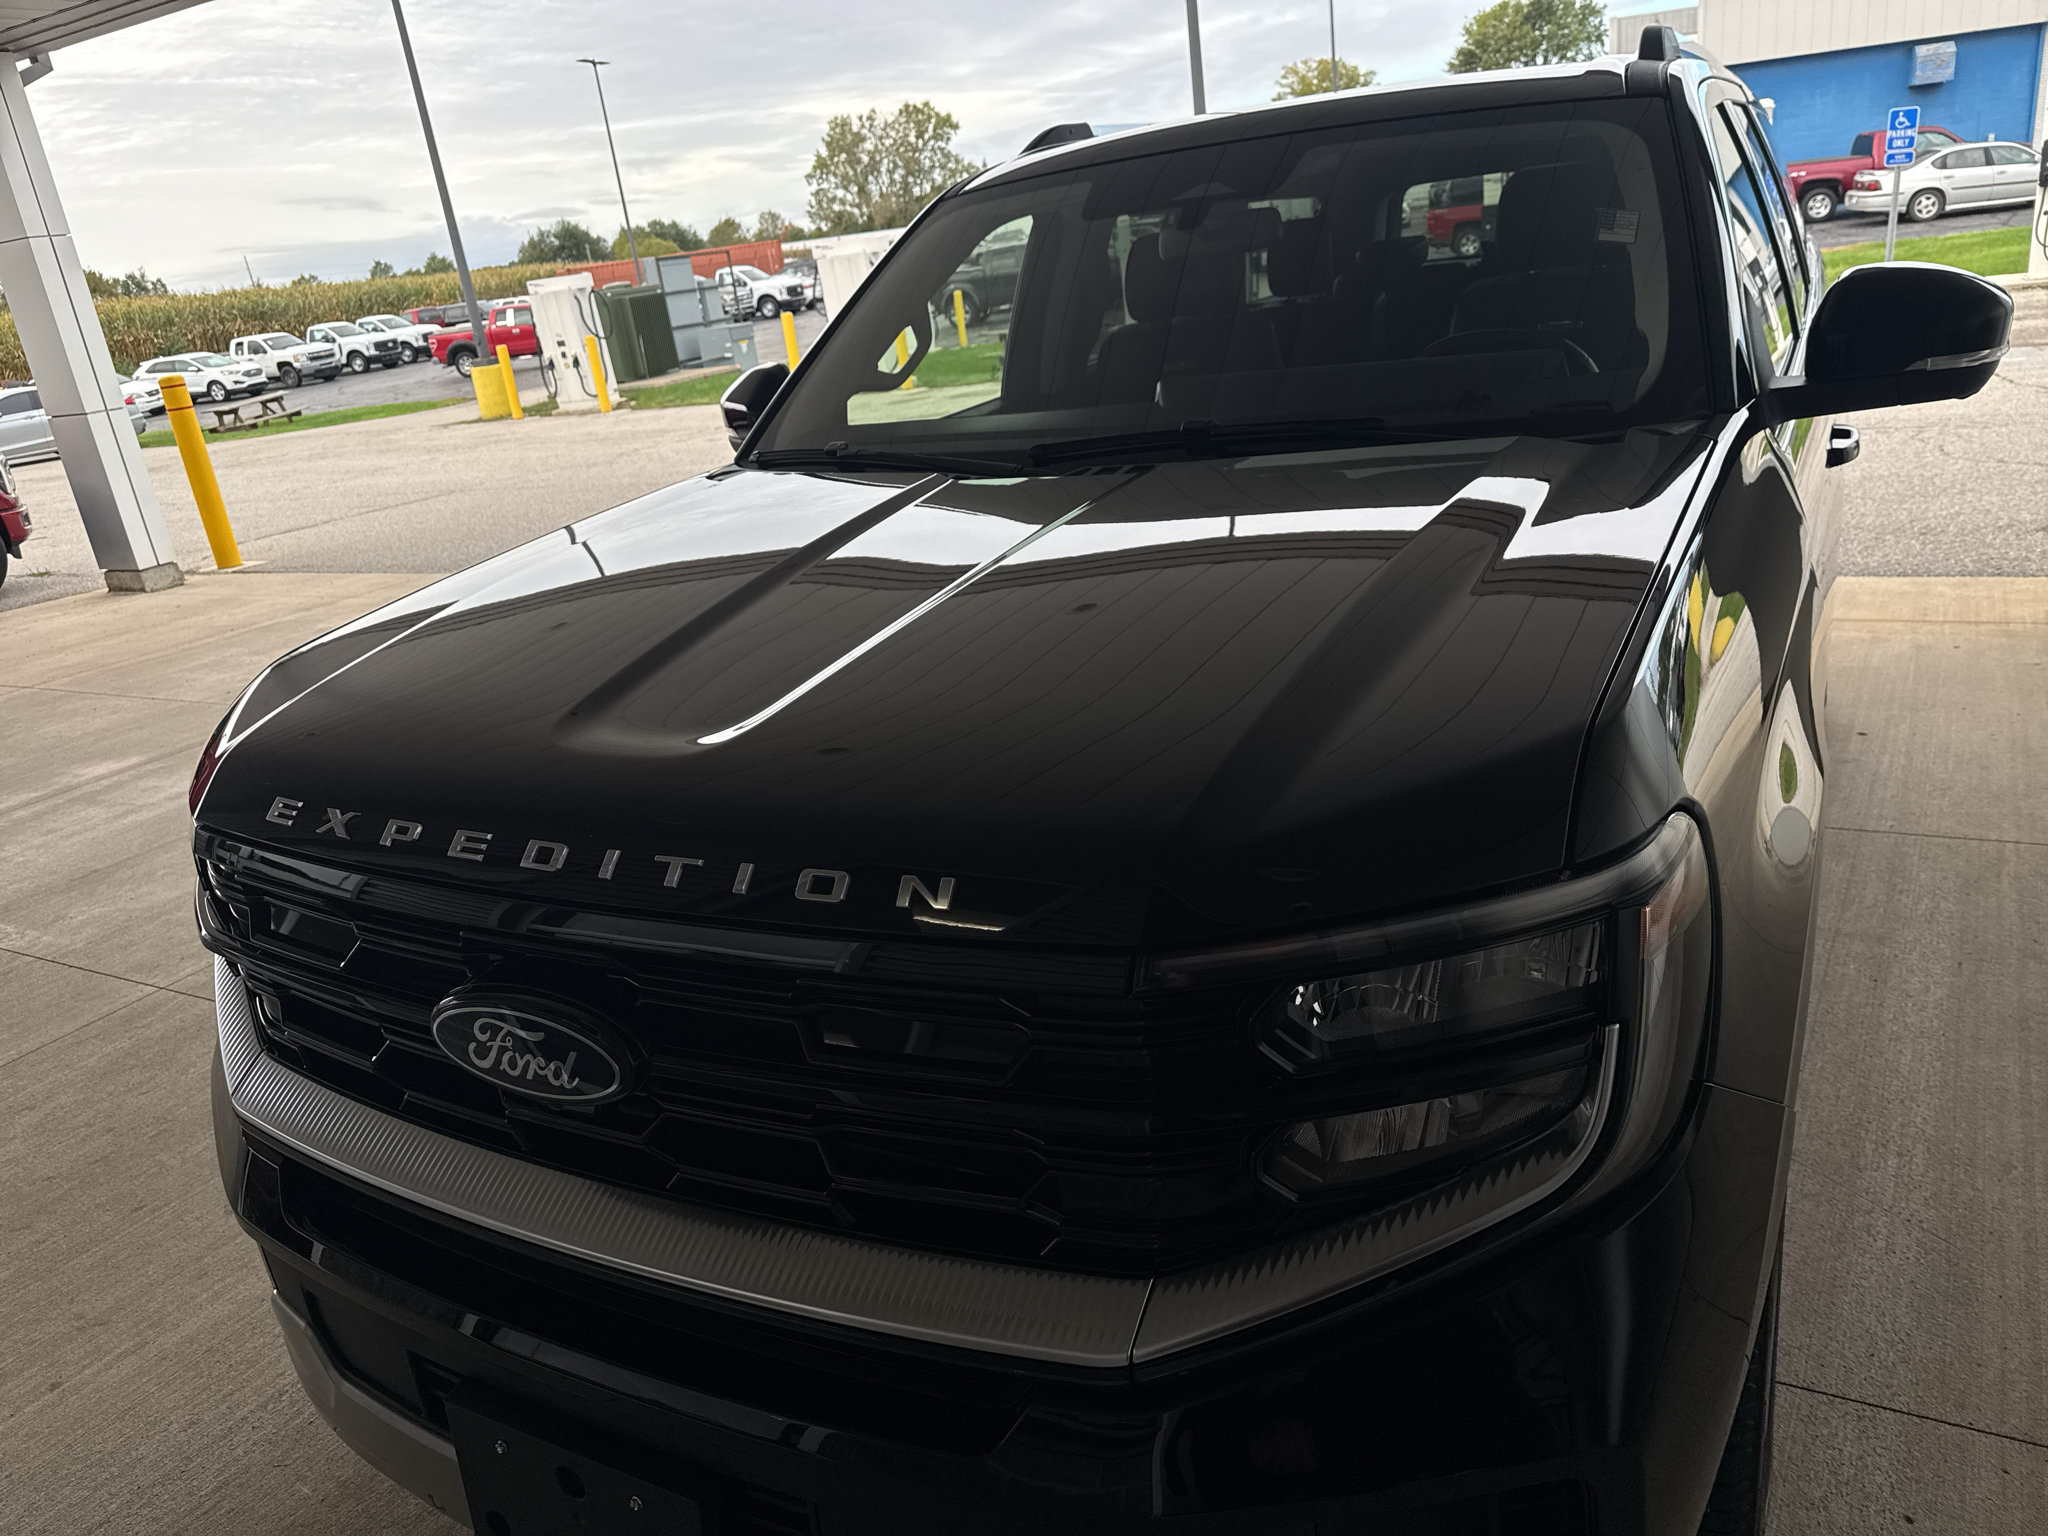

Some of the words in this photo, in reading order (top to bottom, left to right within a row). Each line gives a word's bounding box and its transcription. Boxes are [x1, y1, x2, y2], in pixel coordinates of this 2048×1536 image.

[1887, 128, 1917, 139] PARKING
[1892, 138, 1910, 148] ONLY
[264, 795, 958, 911] EXPEDITION
[468, 1017, 580, 1090] Ford
